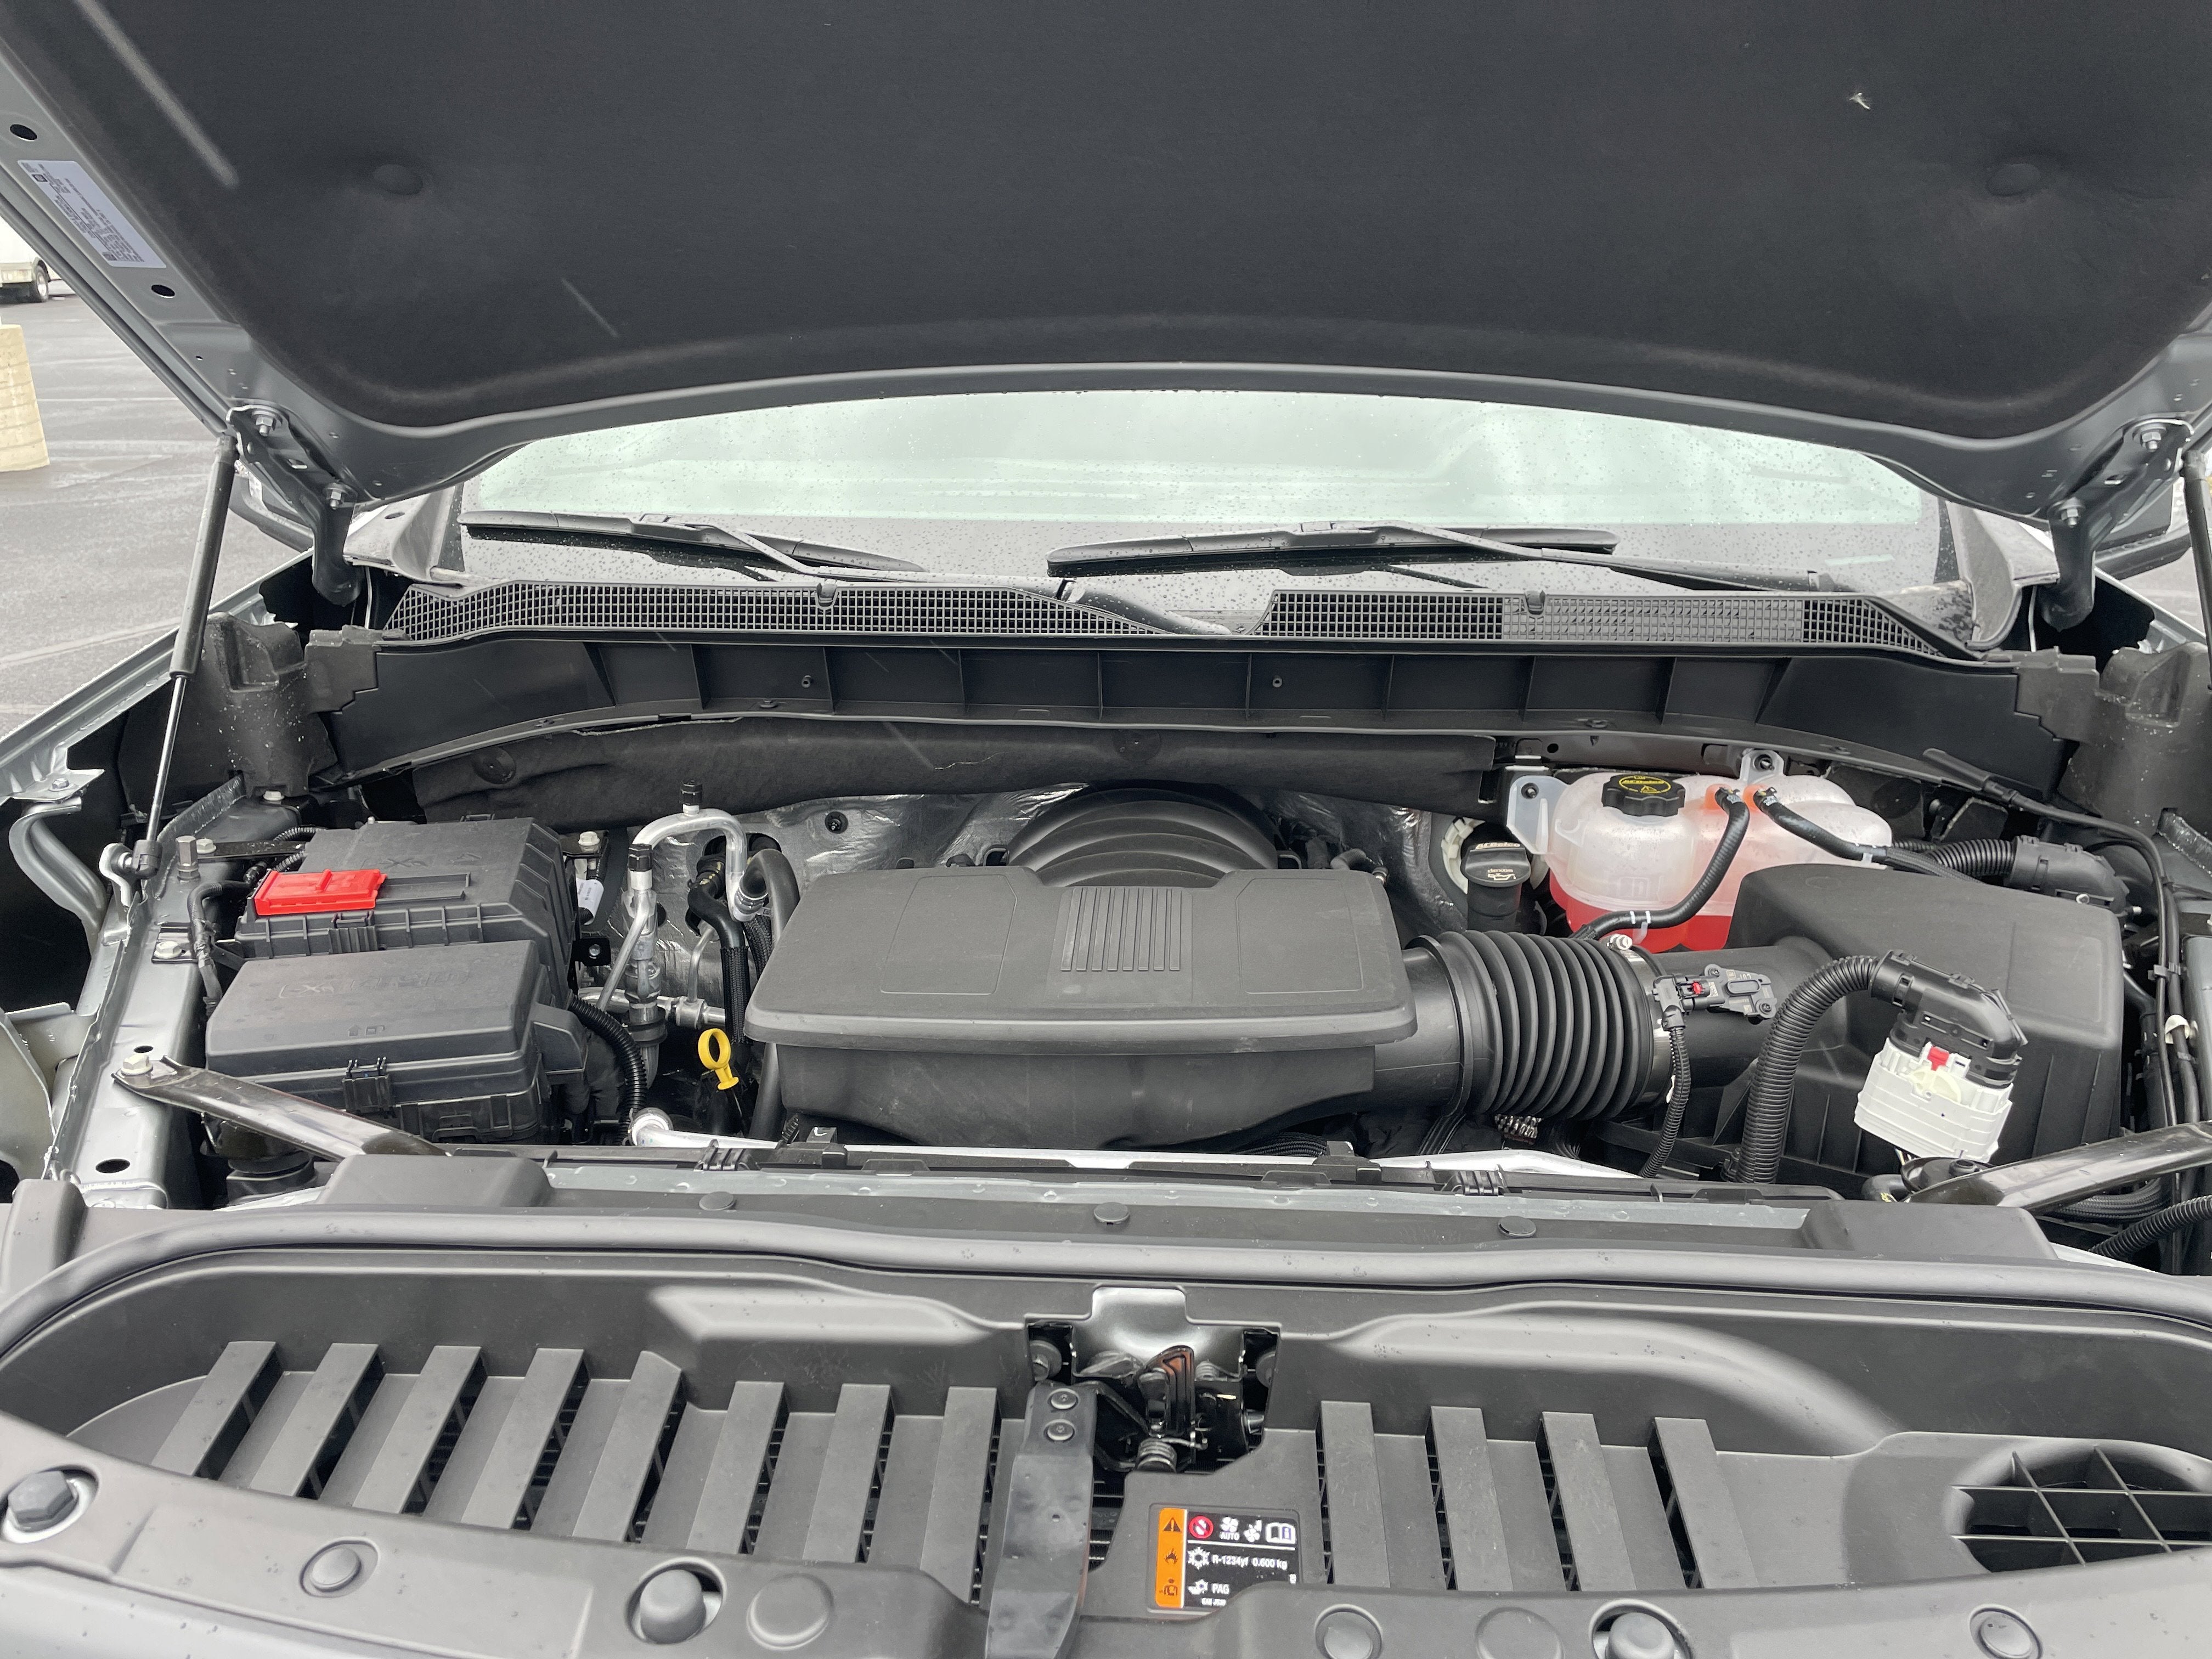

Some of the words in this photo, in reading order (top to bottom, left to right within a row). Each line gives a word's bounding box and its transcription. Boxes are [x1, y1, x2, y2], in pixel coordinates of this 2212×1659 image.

[1220, 1532, 1240, 1541] AUTO
[1212, 1555, 1249, 1567] R-1234yf
[1252, 1557, 1275, 1567] 0.600
[1276, 1559, 1288, 1571] kg
[1212, 1583, 1229, 1594] PAG
